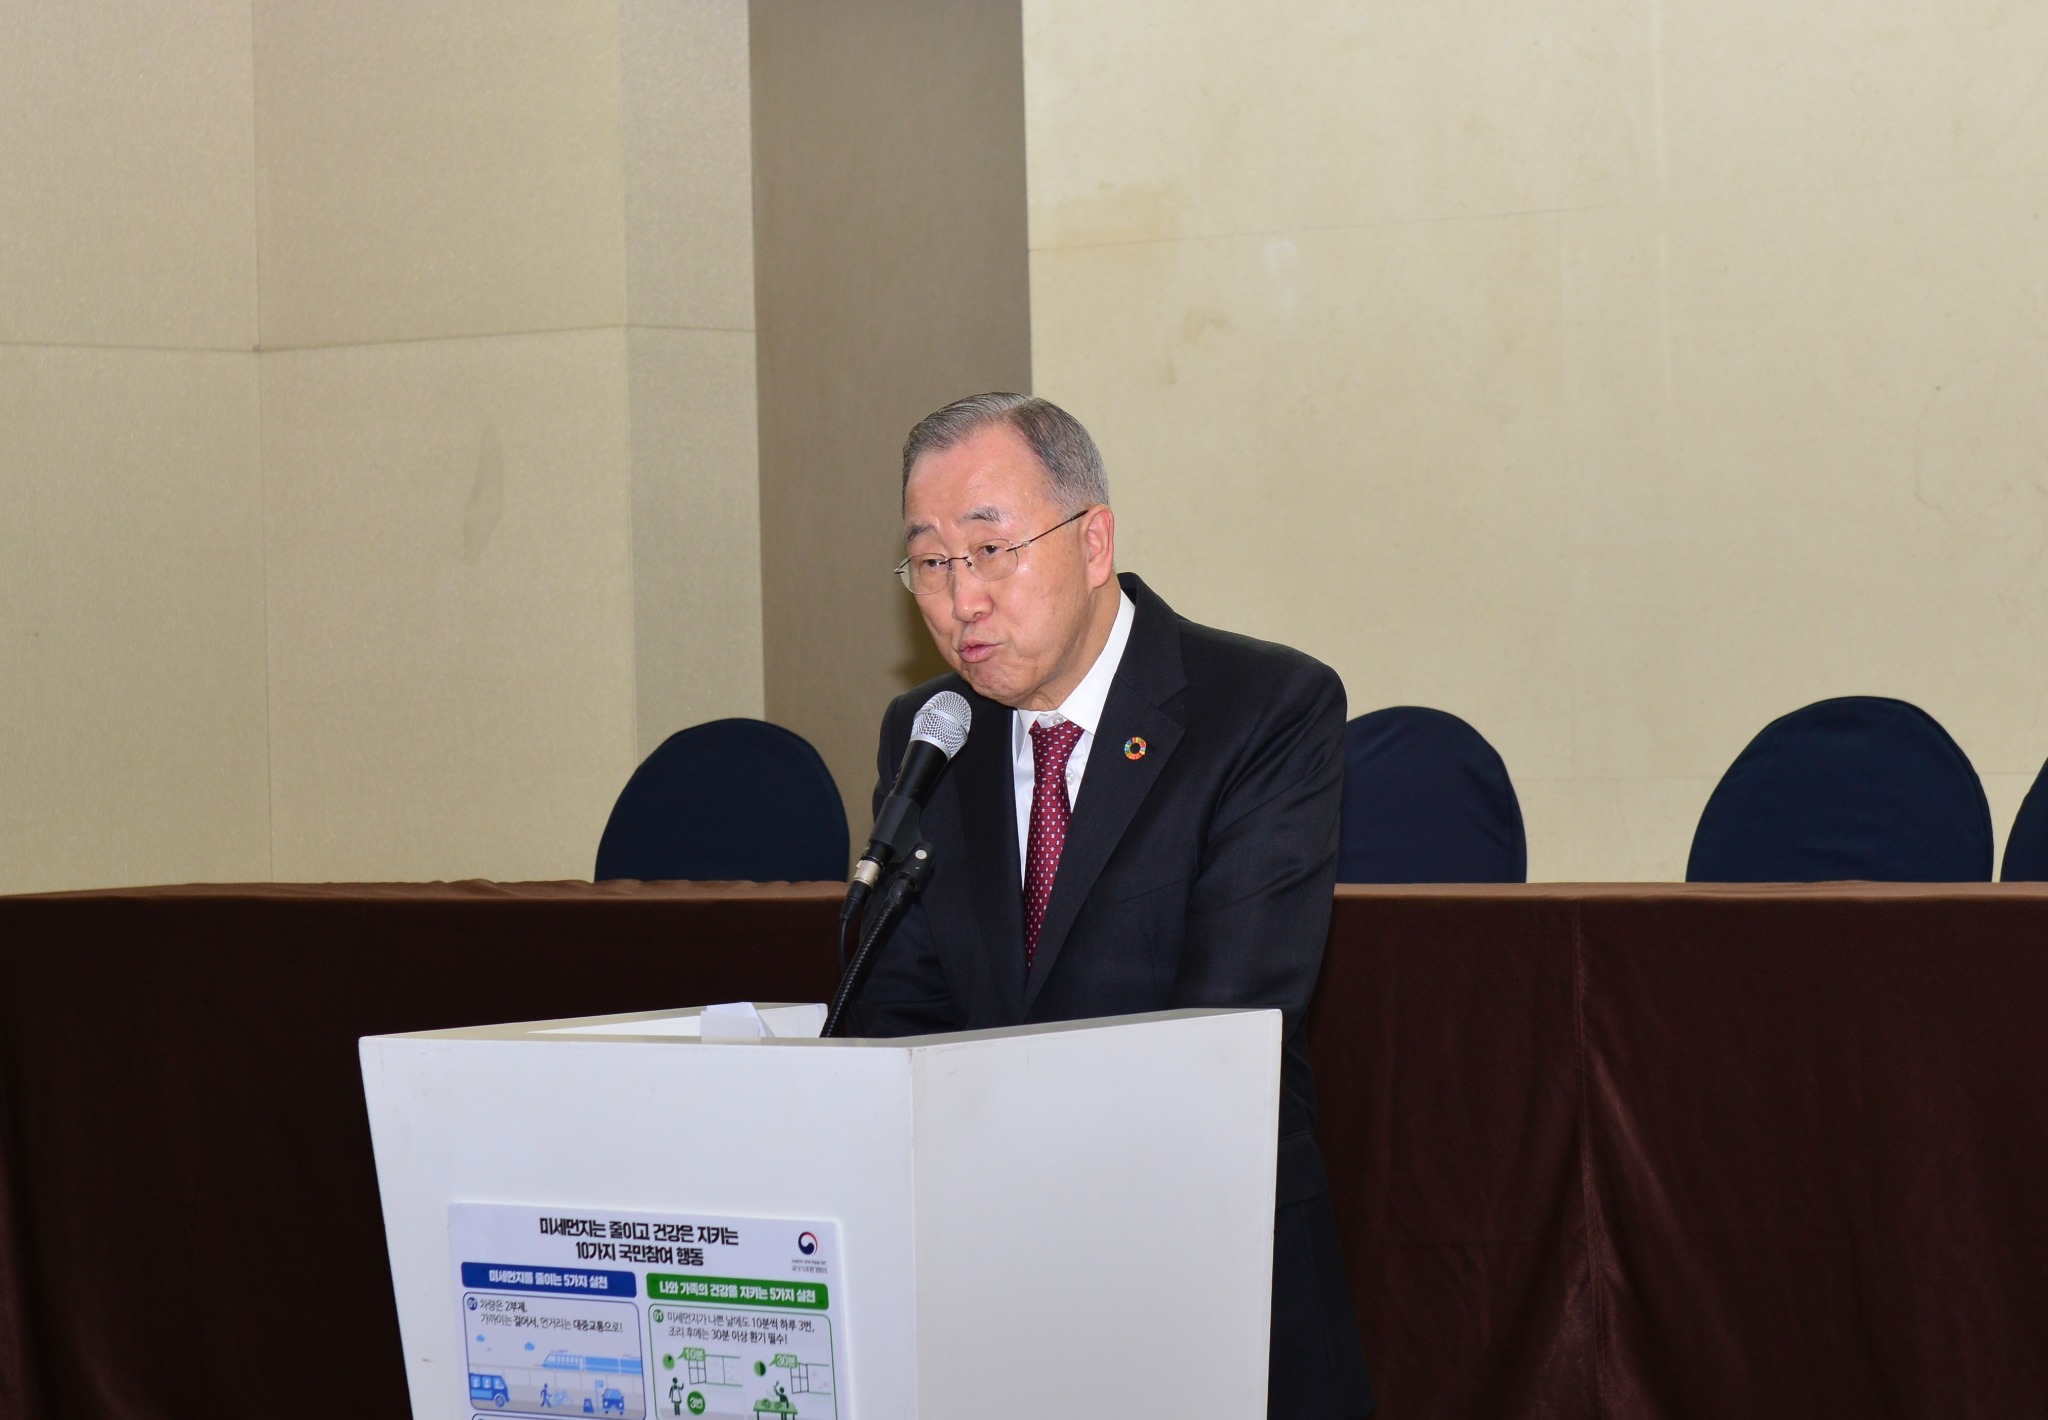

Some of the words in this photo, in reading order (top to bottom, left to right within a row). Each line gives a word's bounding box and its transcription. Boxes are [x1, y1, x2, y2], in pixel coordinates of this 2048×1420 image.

[540, 1217, 606, 1238] 미세먼지는
[609, 1220, 649, 1240] 줄이고
[653, 1223, 694, 1243] 건강은
[698, 1226, 739, 1246] 지키는
[576, 1241, 616, 1262] 10가지
[619, 1244, 673, 1264] 국민참여
[677, 1247, 704, 1266] 행동
[489, 1269, 534, 1285] 미세먼지를
[535, 1272, 562, 1287] 줄이는
[564, 1274, 587, 1288] 5가지
[589, 1275, 608, 1290] 실천
[659, 1280, 679, 1295] 나와
[680, 1282, 708, 1297] 가족의
[710, 1283, 738, 1298] 건강을
[740, 1285, 769, 1301] 지키는
[770, 1287, 794, 1302] 5가지
[796, 1288, 816, 1303] 실천
[669, 1326, 684, 1338] 조리
[711, 1329, 730, 1341] 30분
[731, 1330, 748, 1343] 이상
[750, 1331, 766, 1344] 환기
[768, 1333, 788, 1345] 필수!
[780, 1319, 797, 1331] 하루
